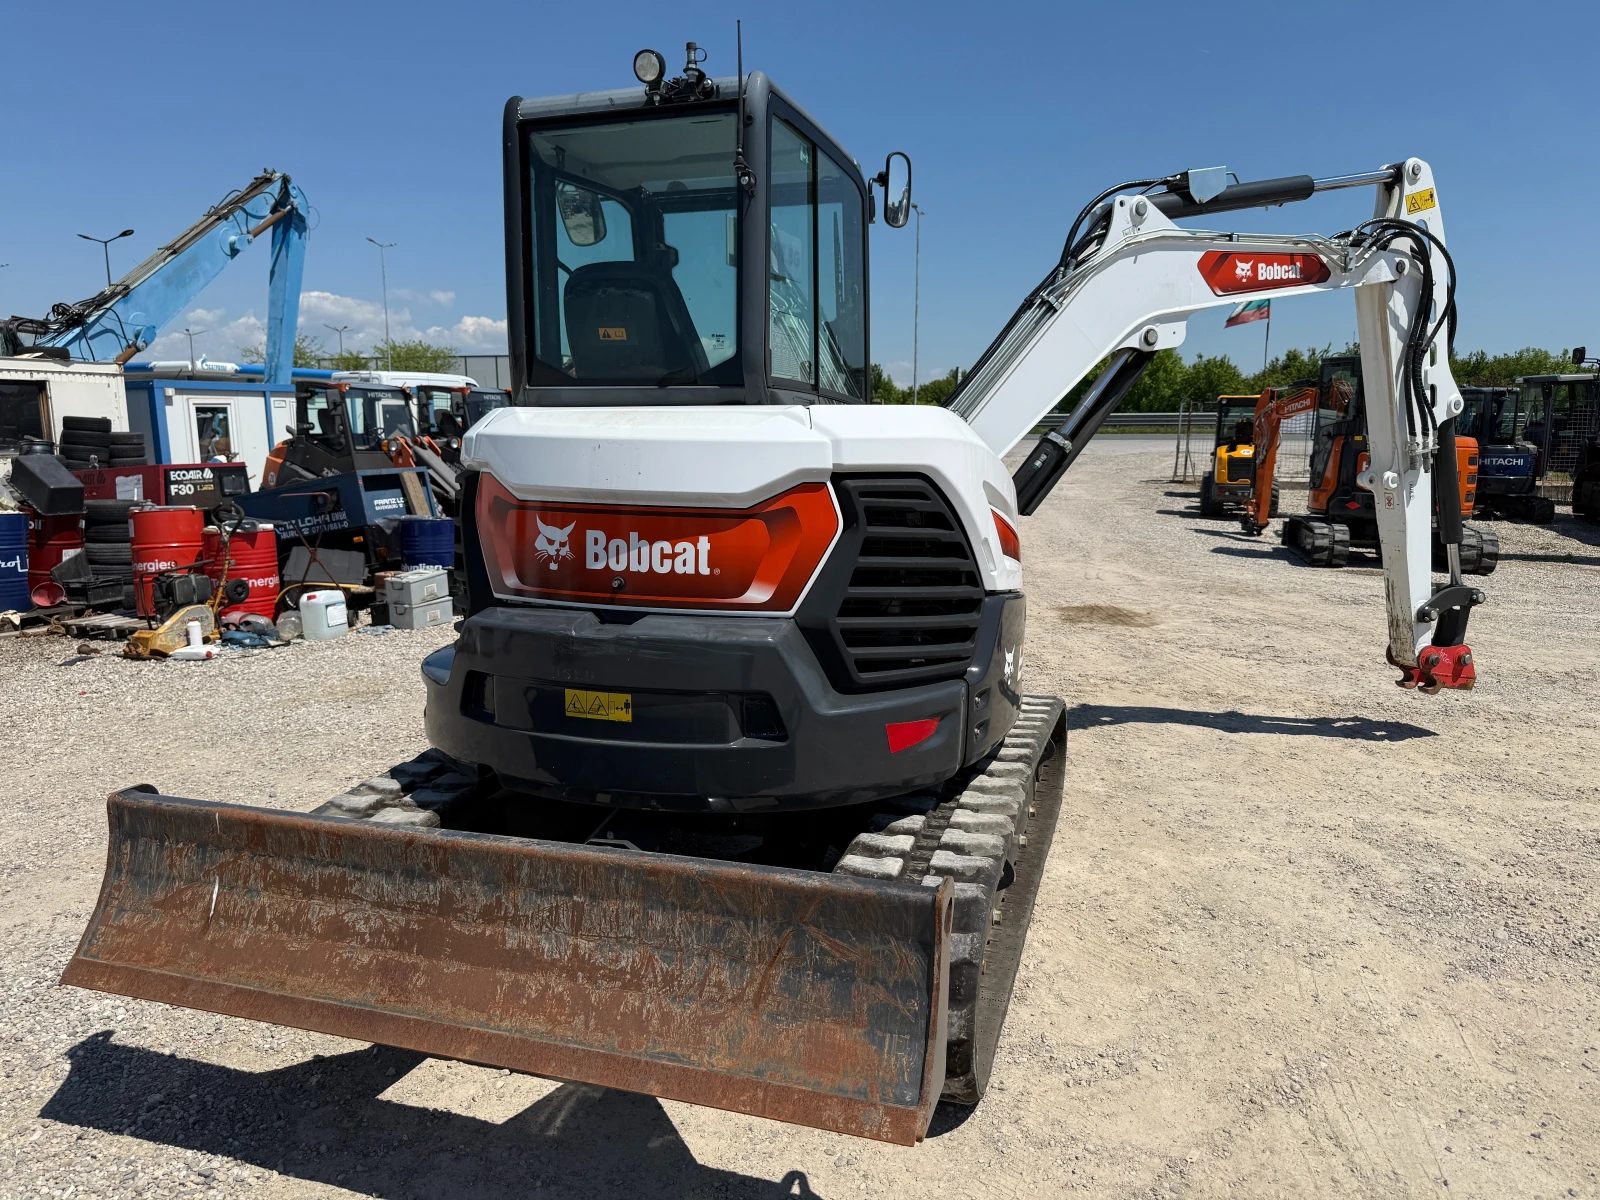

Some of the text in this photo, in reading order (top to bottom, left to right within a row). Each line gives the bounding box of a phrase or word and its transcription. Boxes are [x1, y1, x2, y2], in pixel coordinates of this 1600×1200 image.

[1257, 262, 1301, 281] Bobcat
[367, 391, 392, 399] HITACHI
[1284, 398, 1311, 413] HITACHI
[1478, 457, 1523, 466] HITACHI
[170, 469, 203, 481] ECOAIR
[170, 483, 195, 496] F30
[585, 529, 711, 575] Bobcat
